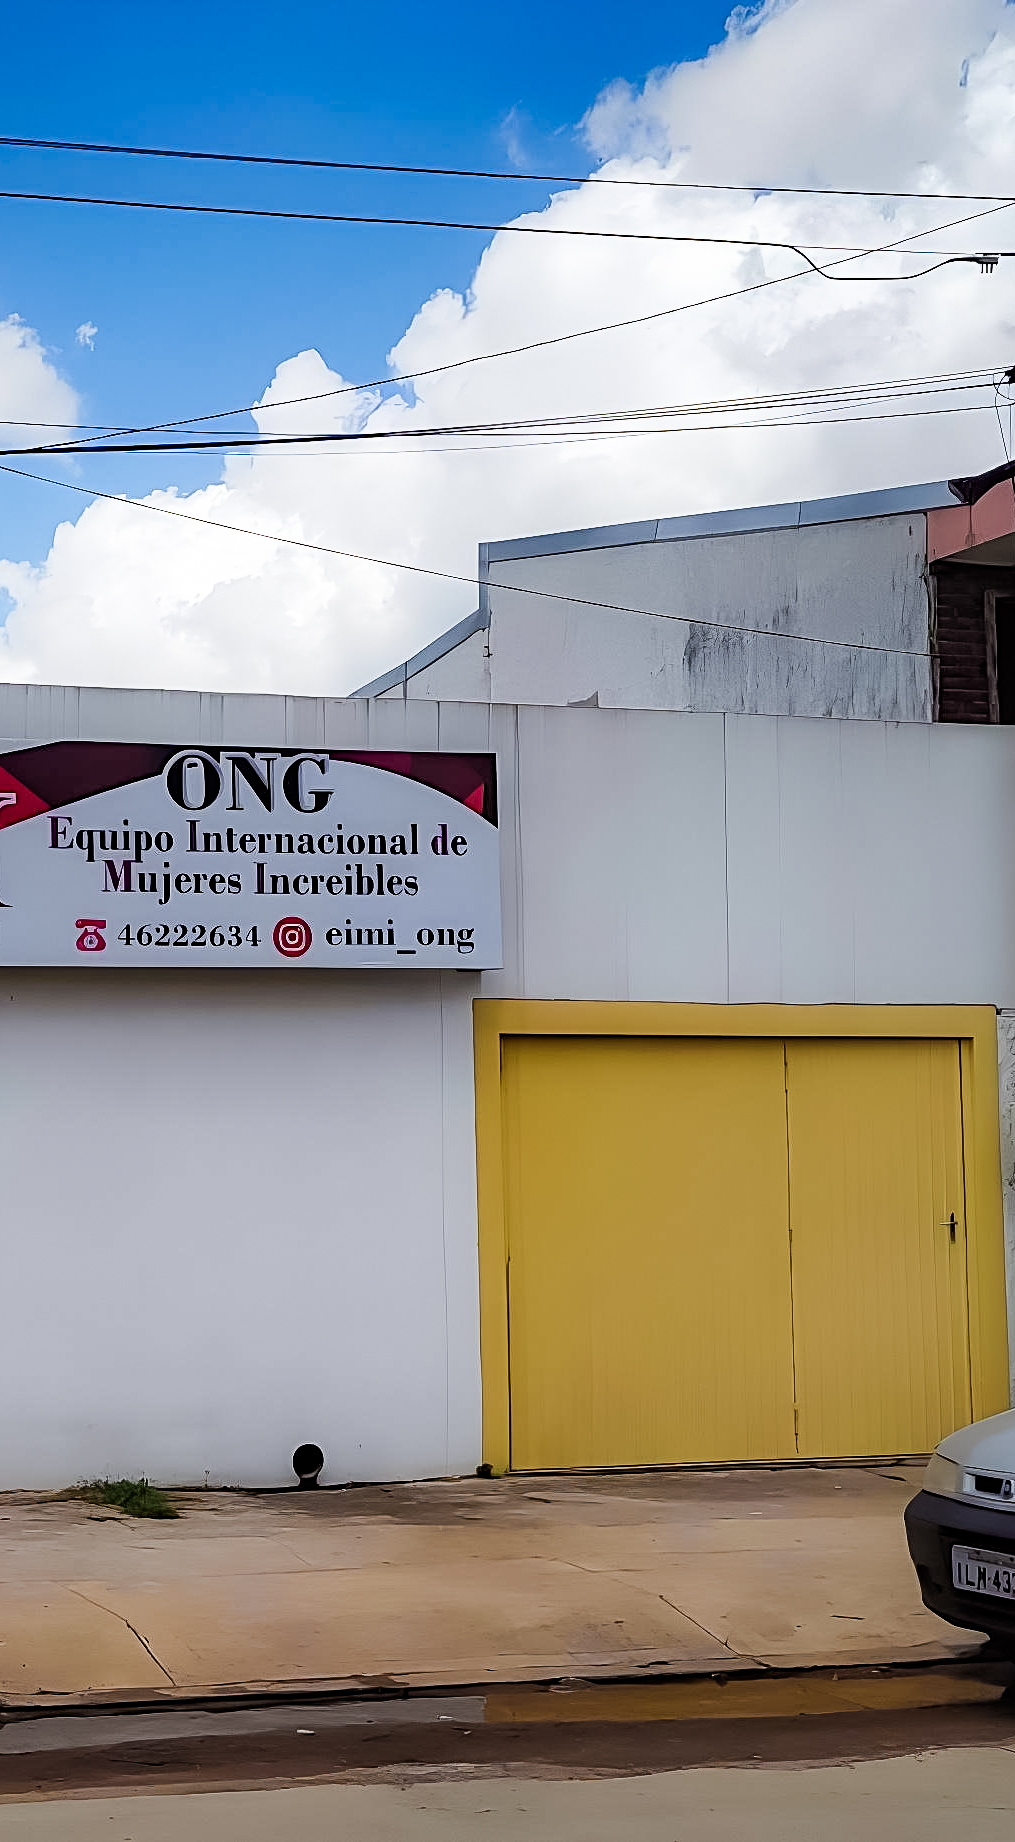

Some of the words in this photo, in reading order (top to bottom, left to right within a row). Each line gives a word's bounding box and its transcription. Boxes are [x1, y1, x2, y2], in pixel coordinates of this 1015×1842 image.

[164, 750, 334, 814] ONG
[48, 816, 174, 862] Equipo
[185, 820, 418, 856] Internacional
[431, 824, 468, 856] de
[101, 859, 242, 905] Mujeres
[254, 862, 419, 896] Increibles
[117, 924, 260, 947] 46222634
[325, 918, 475, 954] eimi_ong
